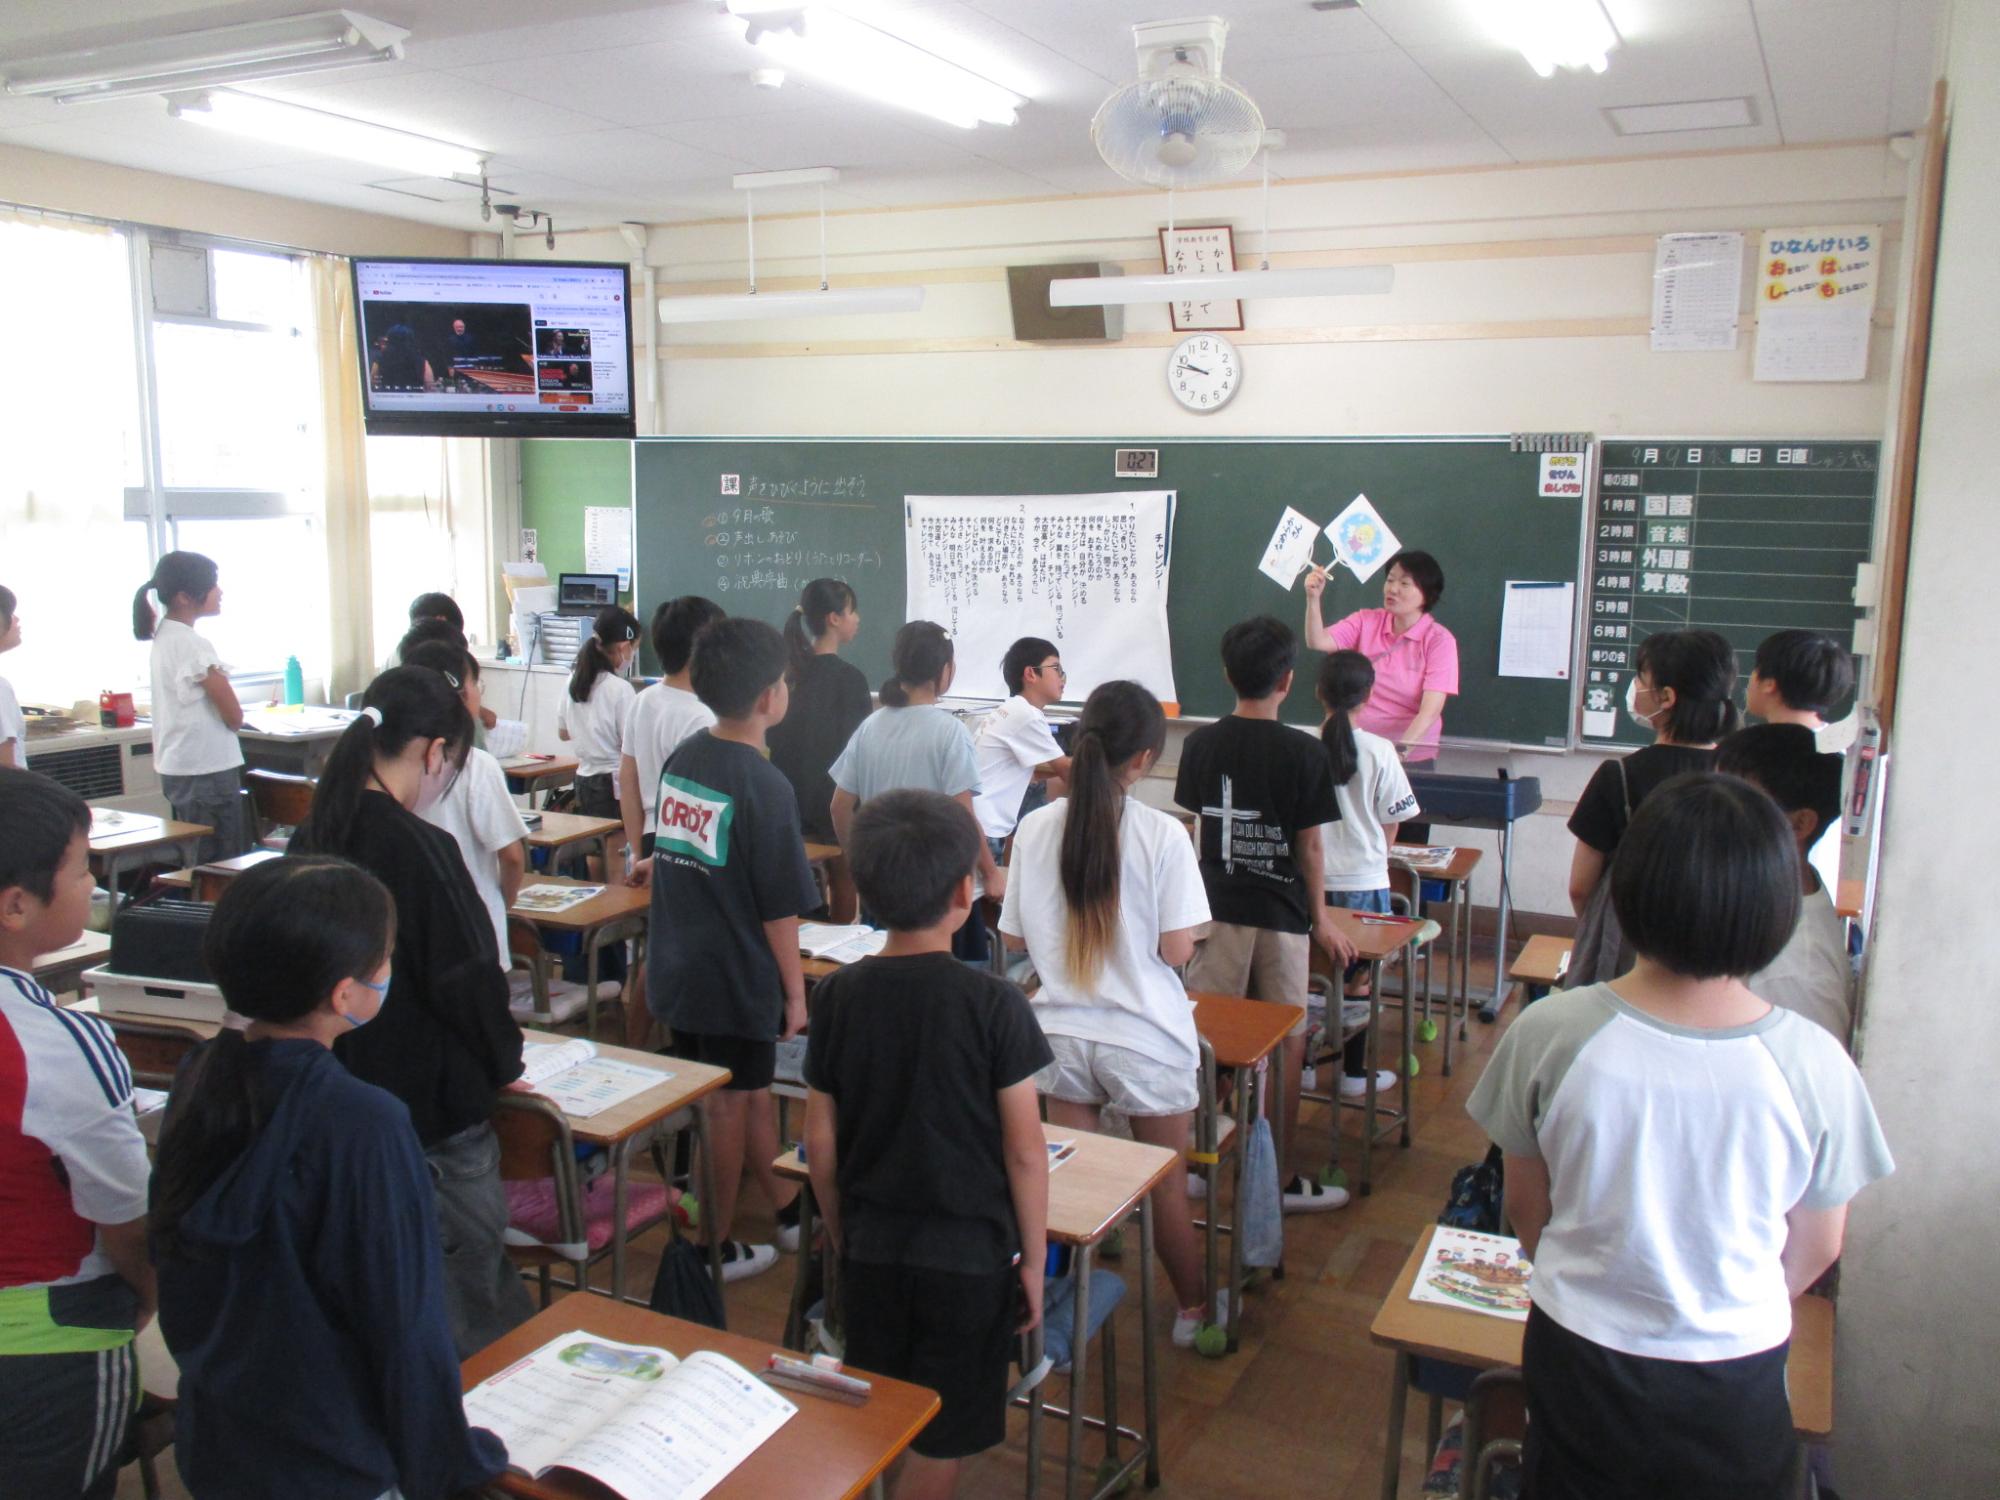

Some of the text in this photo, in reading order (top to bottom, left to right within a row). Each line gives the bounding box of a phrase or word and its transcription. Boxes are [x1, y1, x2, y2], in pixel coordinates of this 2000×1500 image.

[1770, 236, 1870, 254] ひなんけいろ
[1188, 344, 1195, 354] 11
[1200, 341, 1209, 350] 12
[1215, 344, 1219, 353] 1
[1180, 355, 1188, 365] 10
[1222, 353, 1229, 363] 2
[1176, 369, 1182, 378] 9
[1225, 367, 1232, 377] 3
[1180, 382, 1186, 391] 8
[1222, 381, 1228, 390] 4
[1190, 391, 1195, 400] 7
[1200, 394, 1207, 403] 6
[1213, 391, 1220, 400] 5
[1603, 495, 1693, 516] 1時限 国語
[1600, 525, 1688, 544] 2時限 音楽
[1598, 548, 1691, 570] 3時限 外国語
[1596, 572, 1690, 594] 4時限 算数
[1595, 601, 1629, 614] 5時限
[1594, 626, 1627, 639] 6時限
[1592, 651, 1626, 664] 帰りの会
